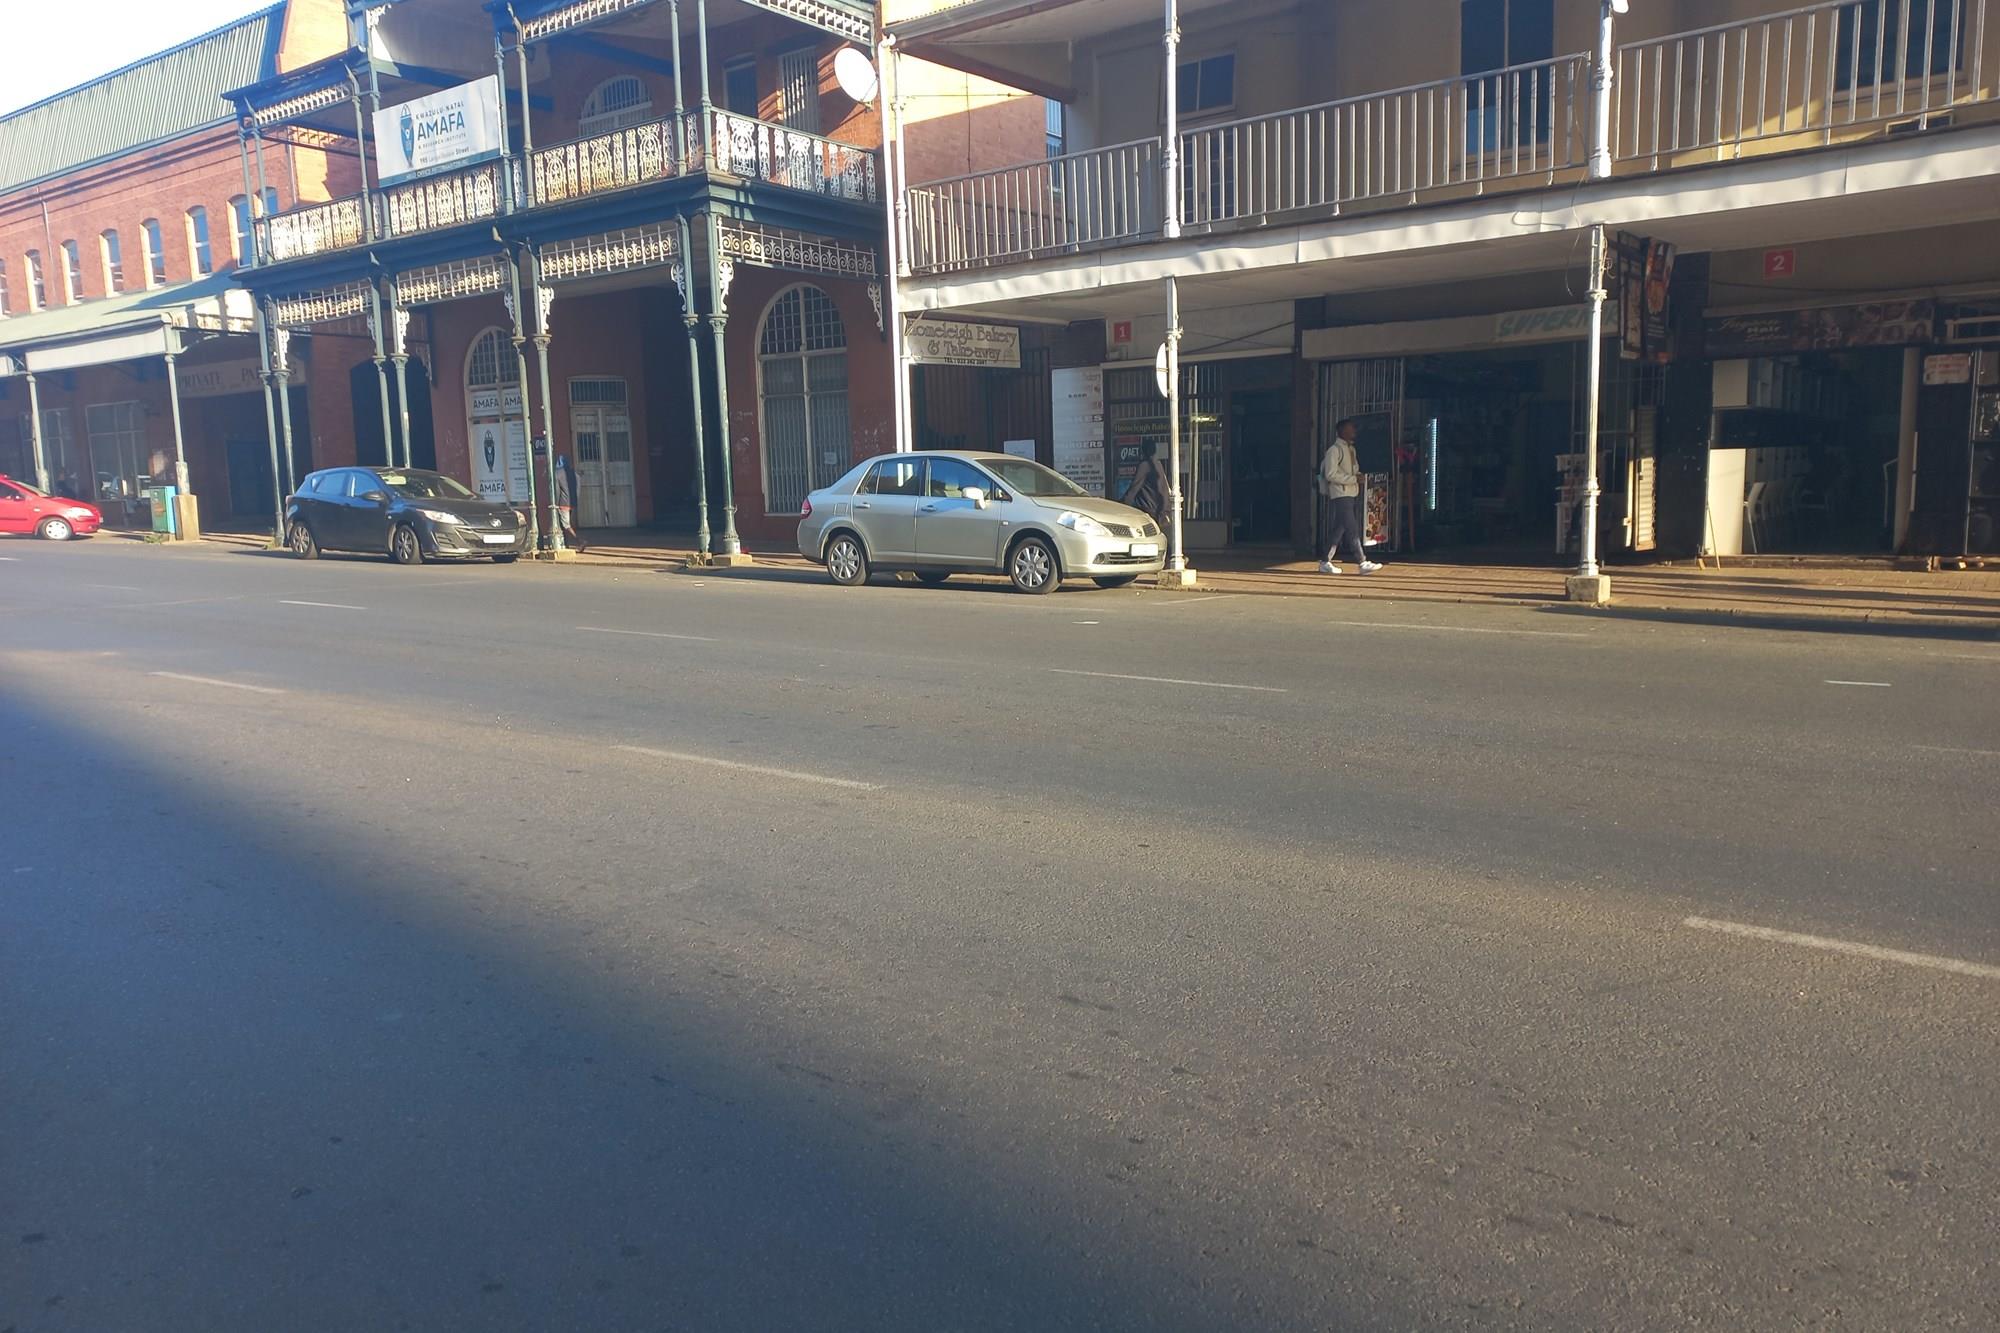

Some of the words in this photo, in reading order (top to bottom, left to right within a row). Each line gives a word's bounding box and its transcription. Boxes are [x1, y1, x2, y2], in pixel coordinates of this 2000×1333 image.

[417, 111, 465, 140] AMAFA
[1773, 255, 1785, 272] 2
[976, 325, 1017, 348] Bakery
[1119, 326, 1126, 338] 1
[928, 339, 940, 355] &
[473, 397, 499, 409] AMAFA
[504, 395, 521, 406] AMA
[479, 482, 506, 493] AMAFA
